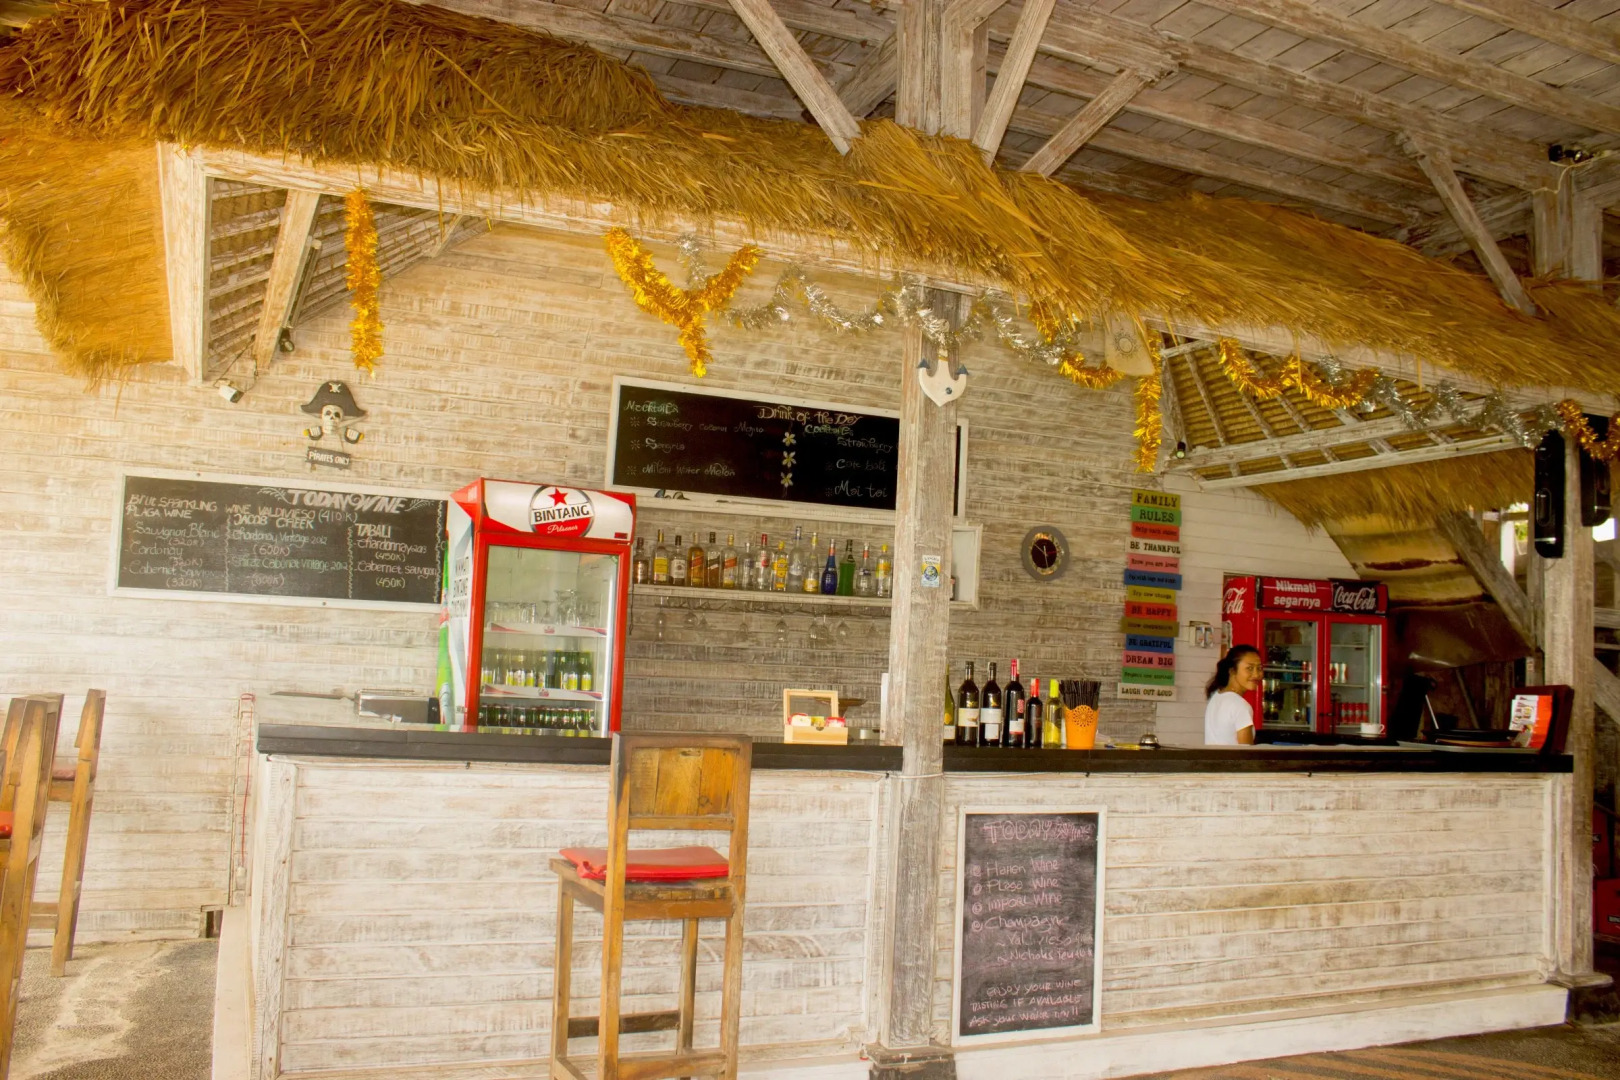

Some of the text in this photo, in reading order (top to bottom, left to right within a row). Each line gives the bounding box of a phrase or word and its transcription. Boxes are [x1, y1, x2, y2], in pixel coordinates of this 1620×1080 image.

[753, 405, 794, 421] Drink
[796, 411, 810, 425] of
[833, 413, 863, 427] Day
[334, 456, 350, 465] ONLY
[1137, 493, 1178, 508] FAMILY
[164, 508, 192, 519] WINE
[226, 504, 251, 514] WINE
[534, 504, 590, 523] BINTANG
[1140, 509, 1175, 523] RULES
[355, 523, 391, 538] TABALI
[547, 524, 579, 534] Pilsener
[1130, 541, 1181, 554] BE THANKFUL
[1276, 580, 1317, 594] Nikmati
[1274, 595, 1320, 610] segarnya
[1126, 655, 1173, 666] DREAM BIG
[1122, 687, 1140, 695] LAUGH
